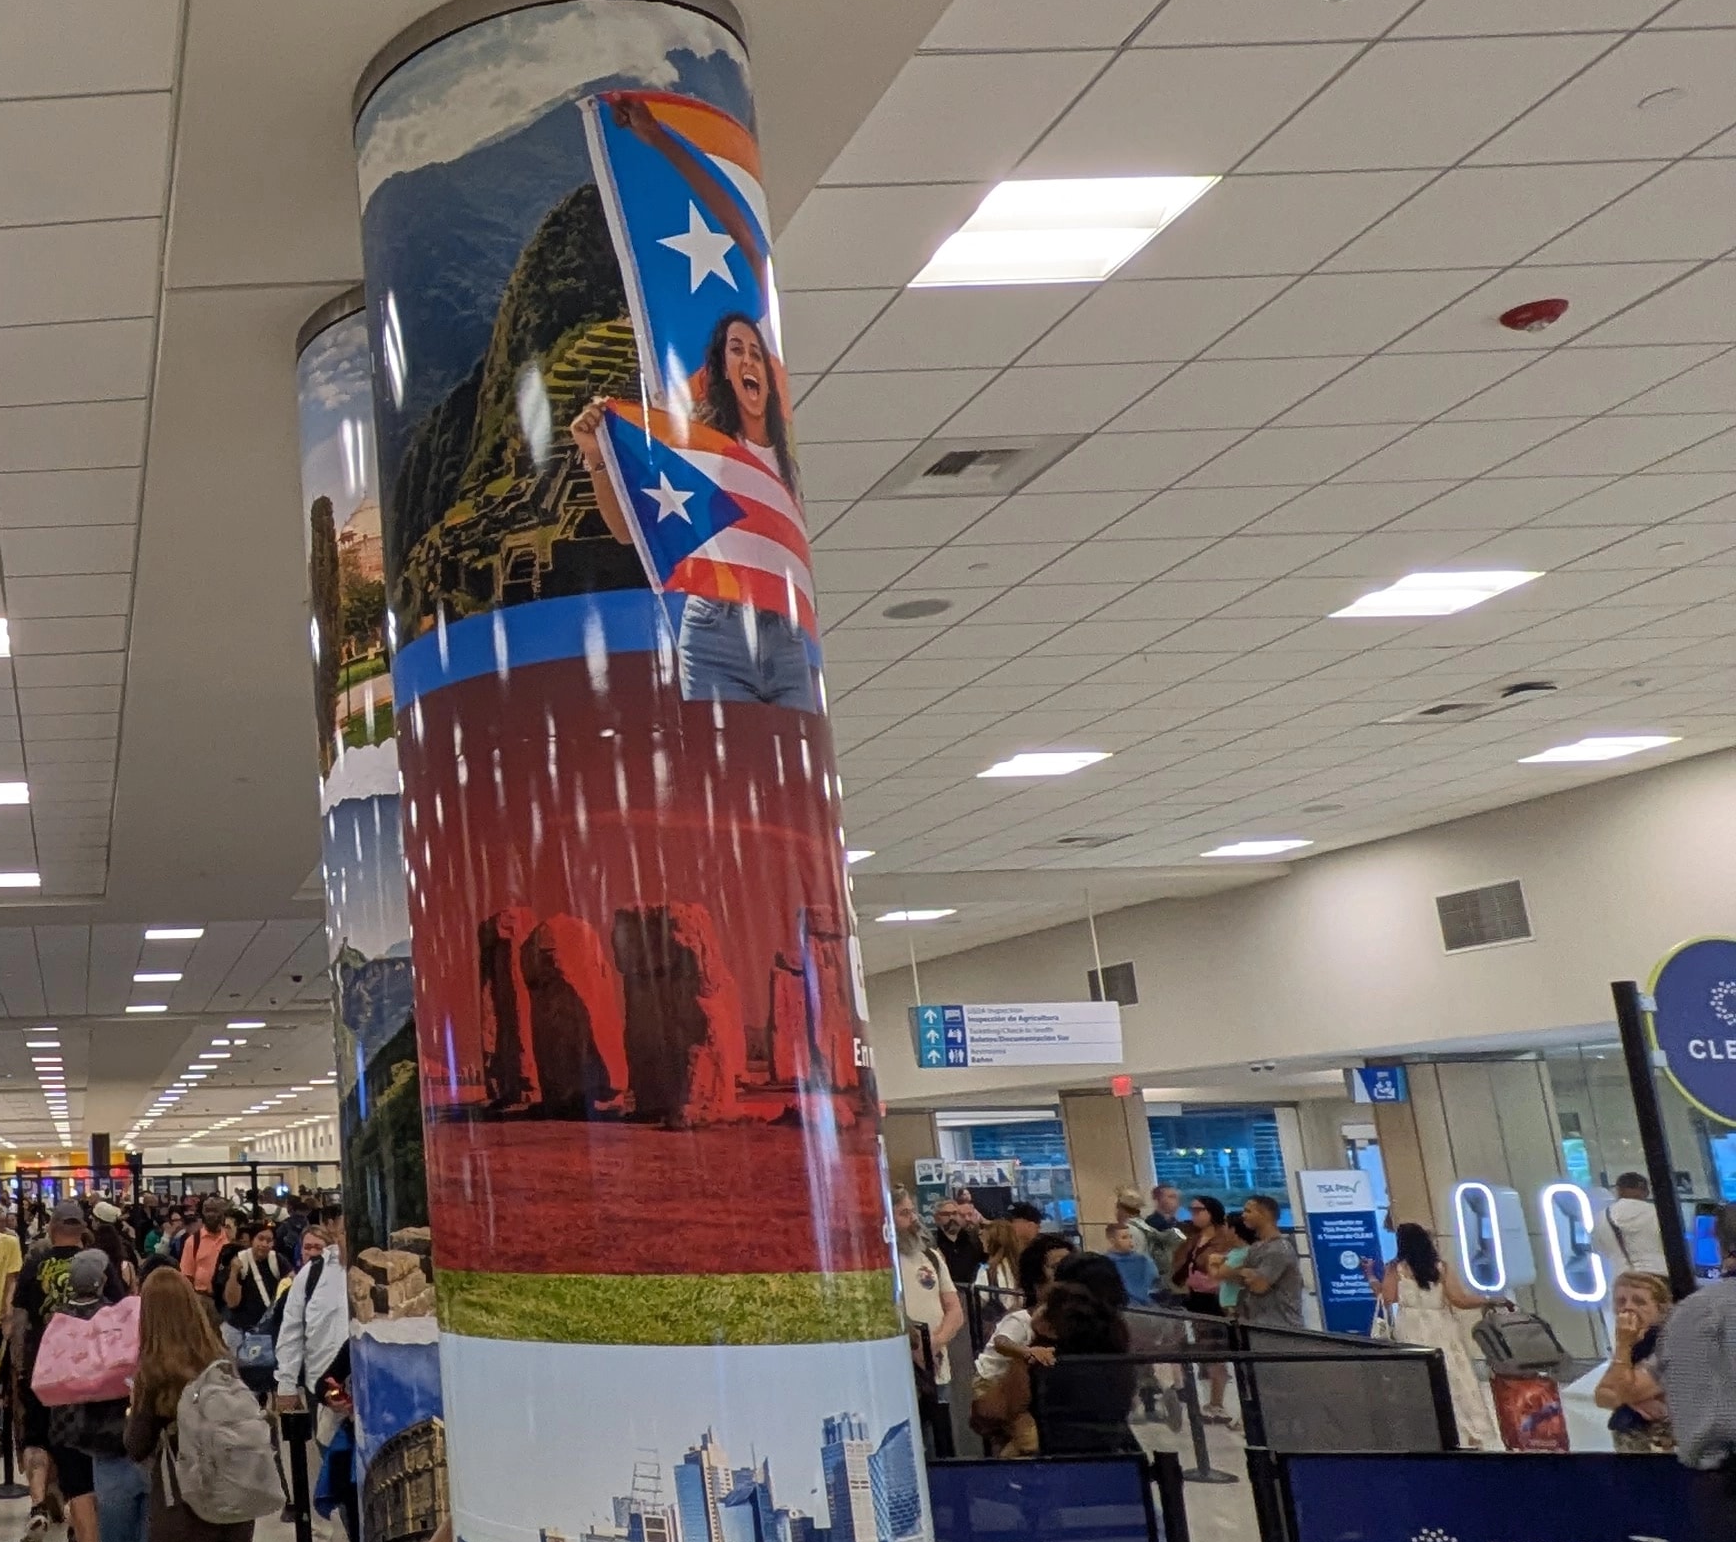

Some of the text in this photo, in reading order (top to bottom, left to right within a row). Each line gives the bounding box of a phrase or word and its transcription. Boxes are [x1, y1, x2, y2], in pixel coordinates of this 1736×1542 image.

[1018, 1014, 1059, 1023] Agricultura
[1688, 1039, 1736, 1059] CLE
[1317, 1184, 1334, 1194] TSA
